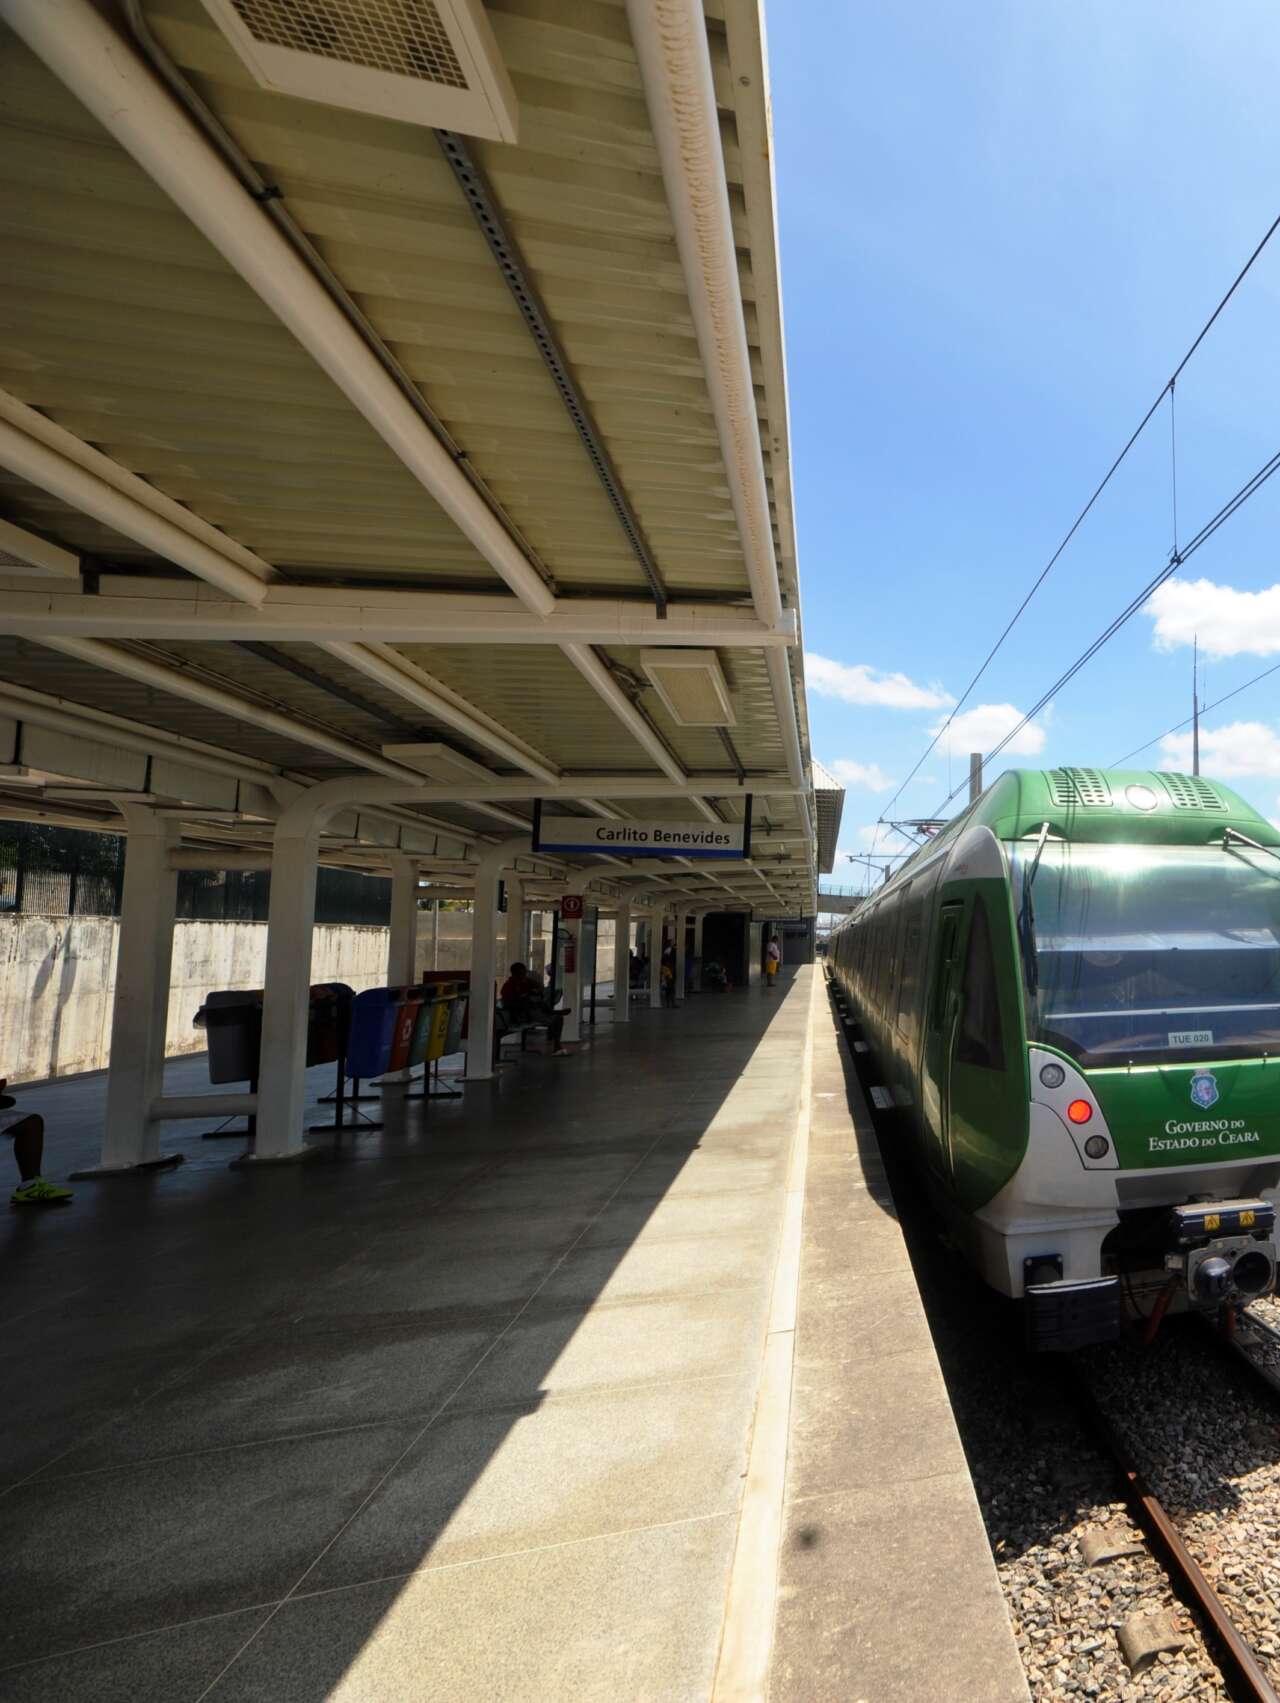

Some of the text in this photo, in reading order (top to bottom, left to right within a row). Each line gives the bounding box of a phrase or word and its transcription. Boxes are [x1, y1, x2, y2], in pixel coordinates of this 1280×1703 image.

[596, 827, 730, 845] Carlito Benevides
[1173, 1035, 1193, 1044] TUE
[1165, 1119, 1245, 1134] GOVERNO DO
[1149, 1136, 1200, 1151] ESTADO
[1201, 1137, 1216, 1147] DO
